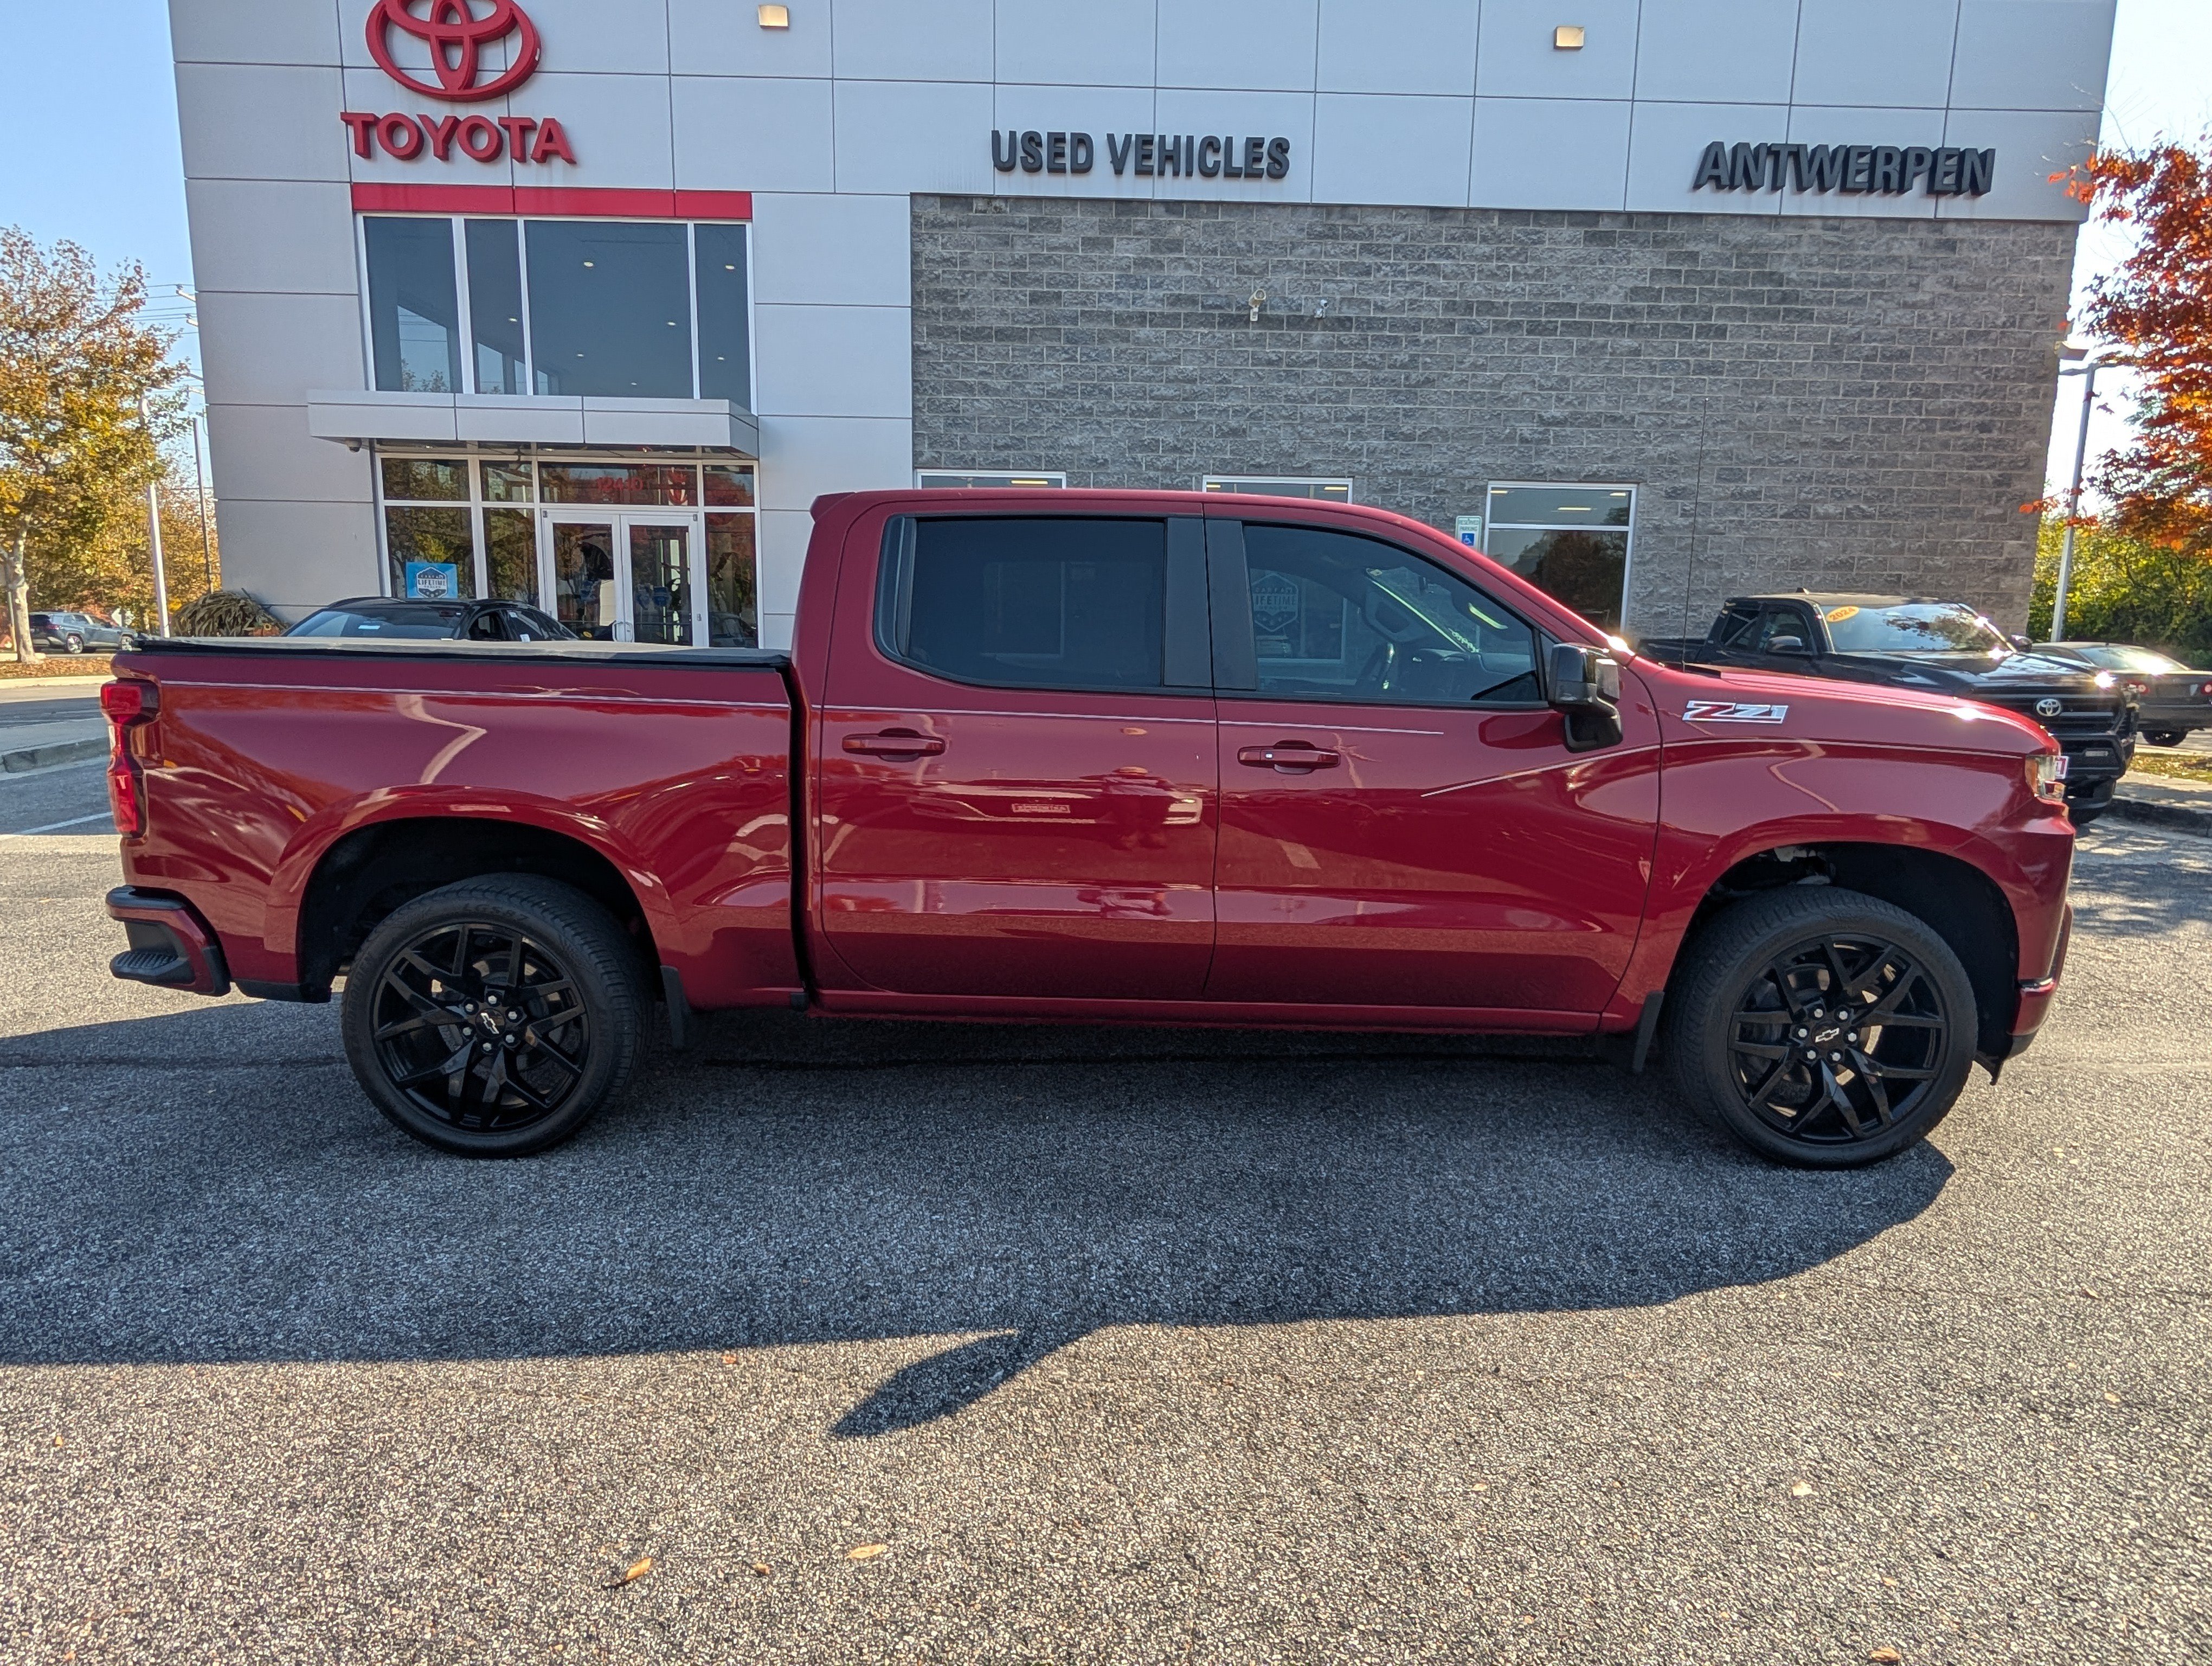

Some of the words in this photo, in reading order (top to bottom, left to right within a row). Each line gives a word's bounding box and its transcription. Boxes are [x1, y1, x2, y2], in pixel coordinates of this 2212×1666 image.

[340, 112, 577, 164] TOYOTA
[992, 130, 1094, 172] USED
[1107, 133, 1290, 179] VEHICLES
[1693, 141, 1996, 196] ANTWERPEN
[1255, 595, 1297, 605] IFETIME
[1829, 607, 1856, 620] 2024
[1682, 700, 1789, 724] Z71
